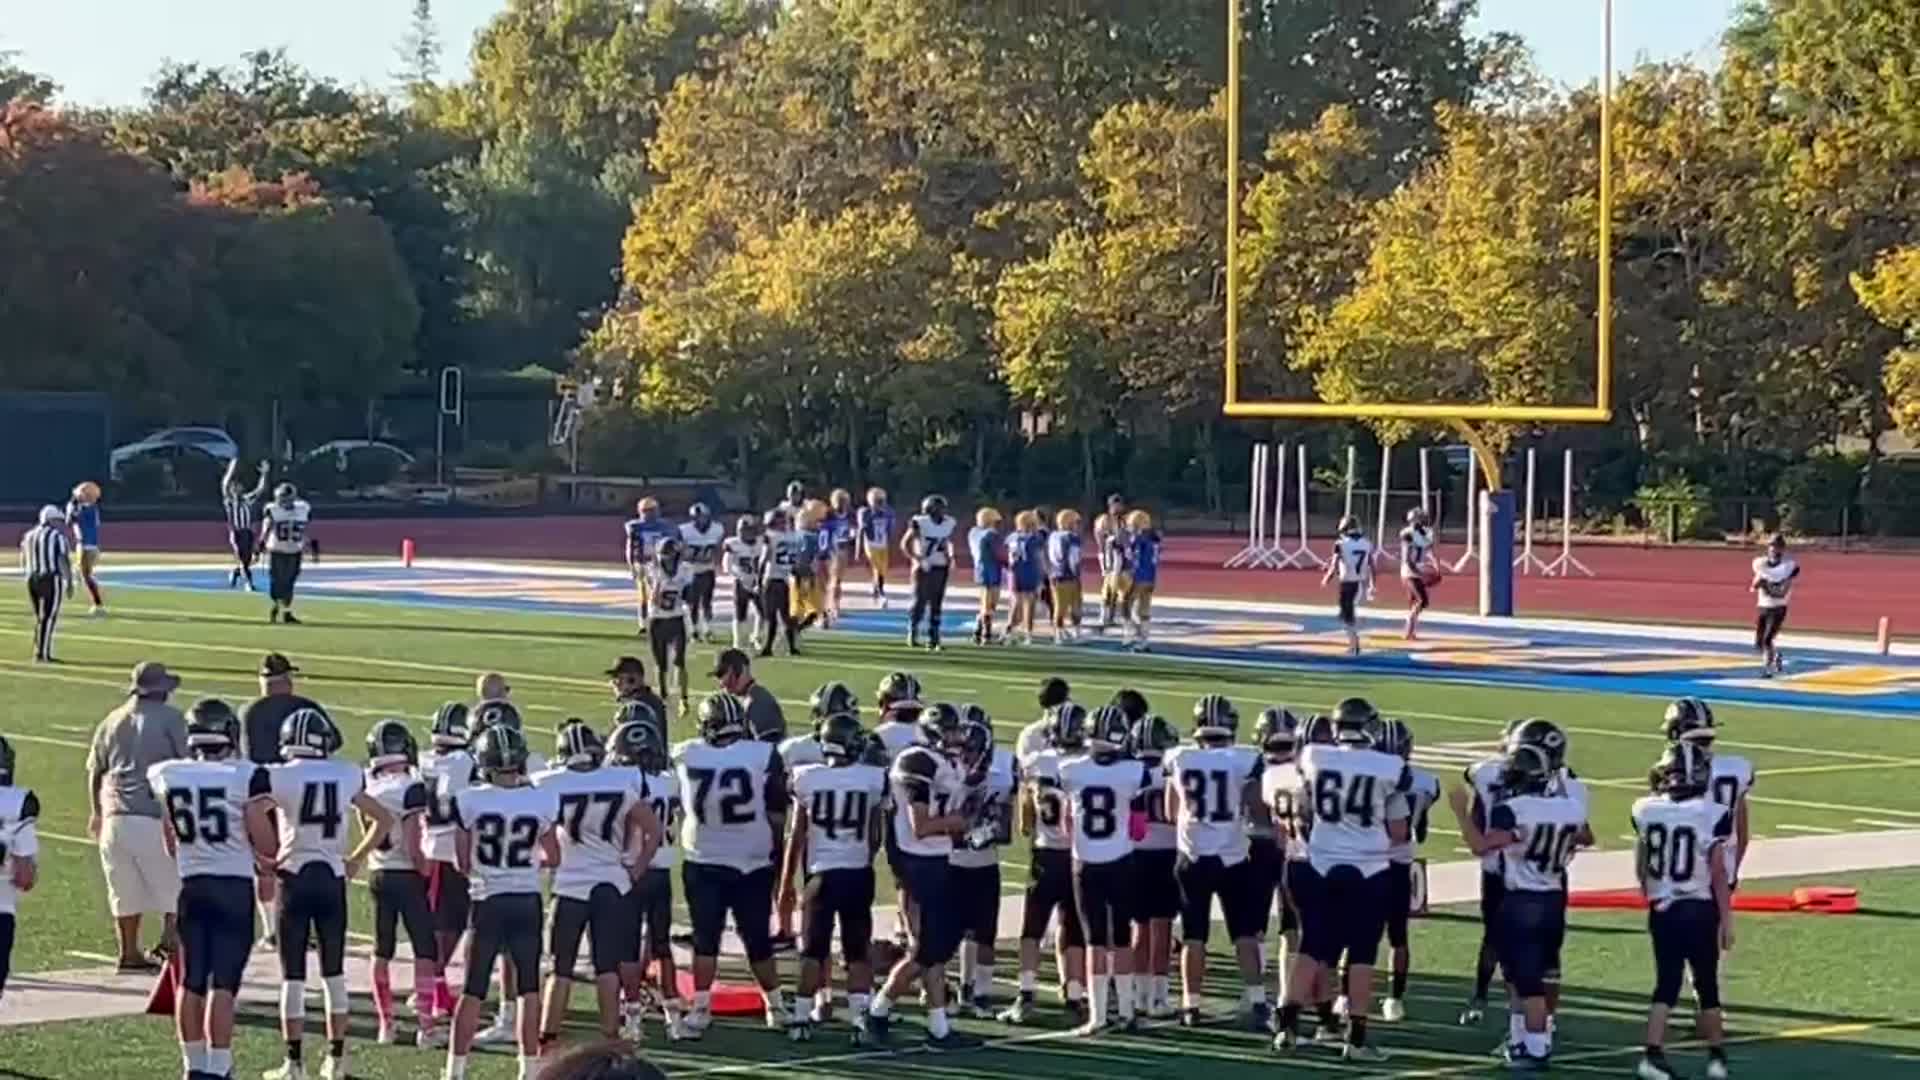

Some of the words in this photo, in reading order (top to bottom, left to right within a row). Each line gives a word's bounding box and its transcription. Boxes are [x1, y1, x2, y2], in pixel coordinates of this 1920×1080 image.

[1352, 549, 1366, 575] 7
[166, 787, 228, 844] 65
[300, 782, 342, 839] 4
[559, 791, 625, 843] 77
[686, 767, 757, 825] 72
[812, 790, 869, 841] 44
[1082, 786, 1117, 840] 8
[1315, 770, 1376, 827] 64
[476, 812, 542, 868] 32
[1646, 822, 1697, 882] 80
